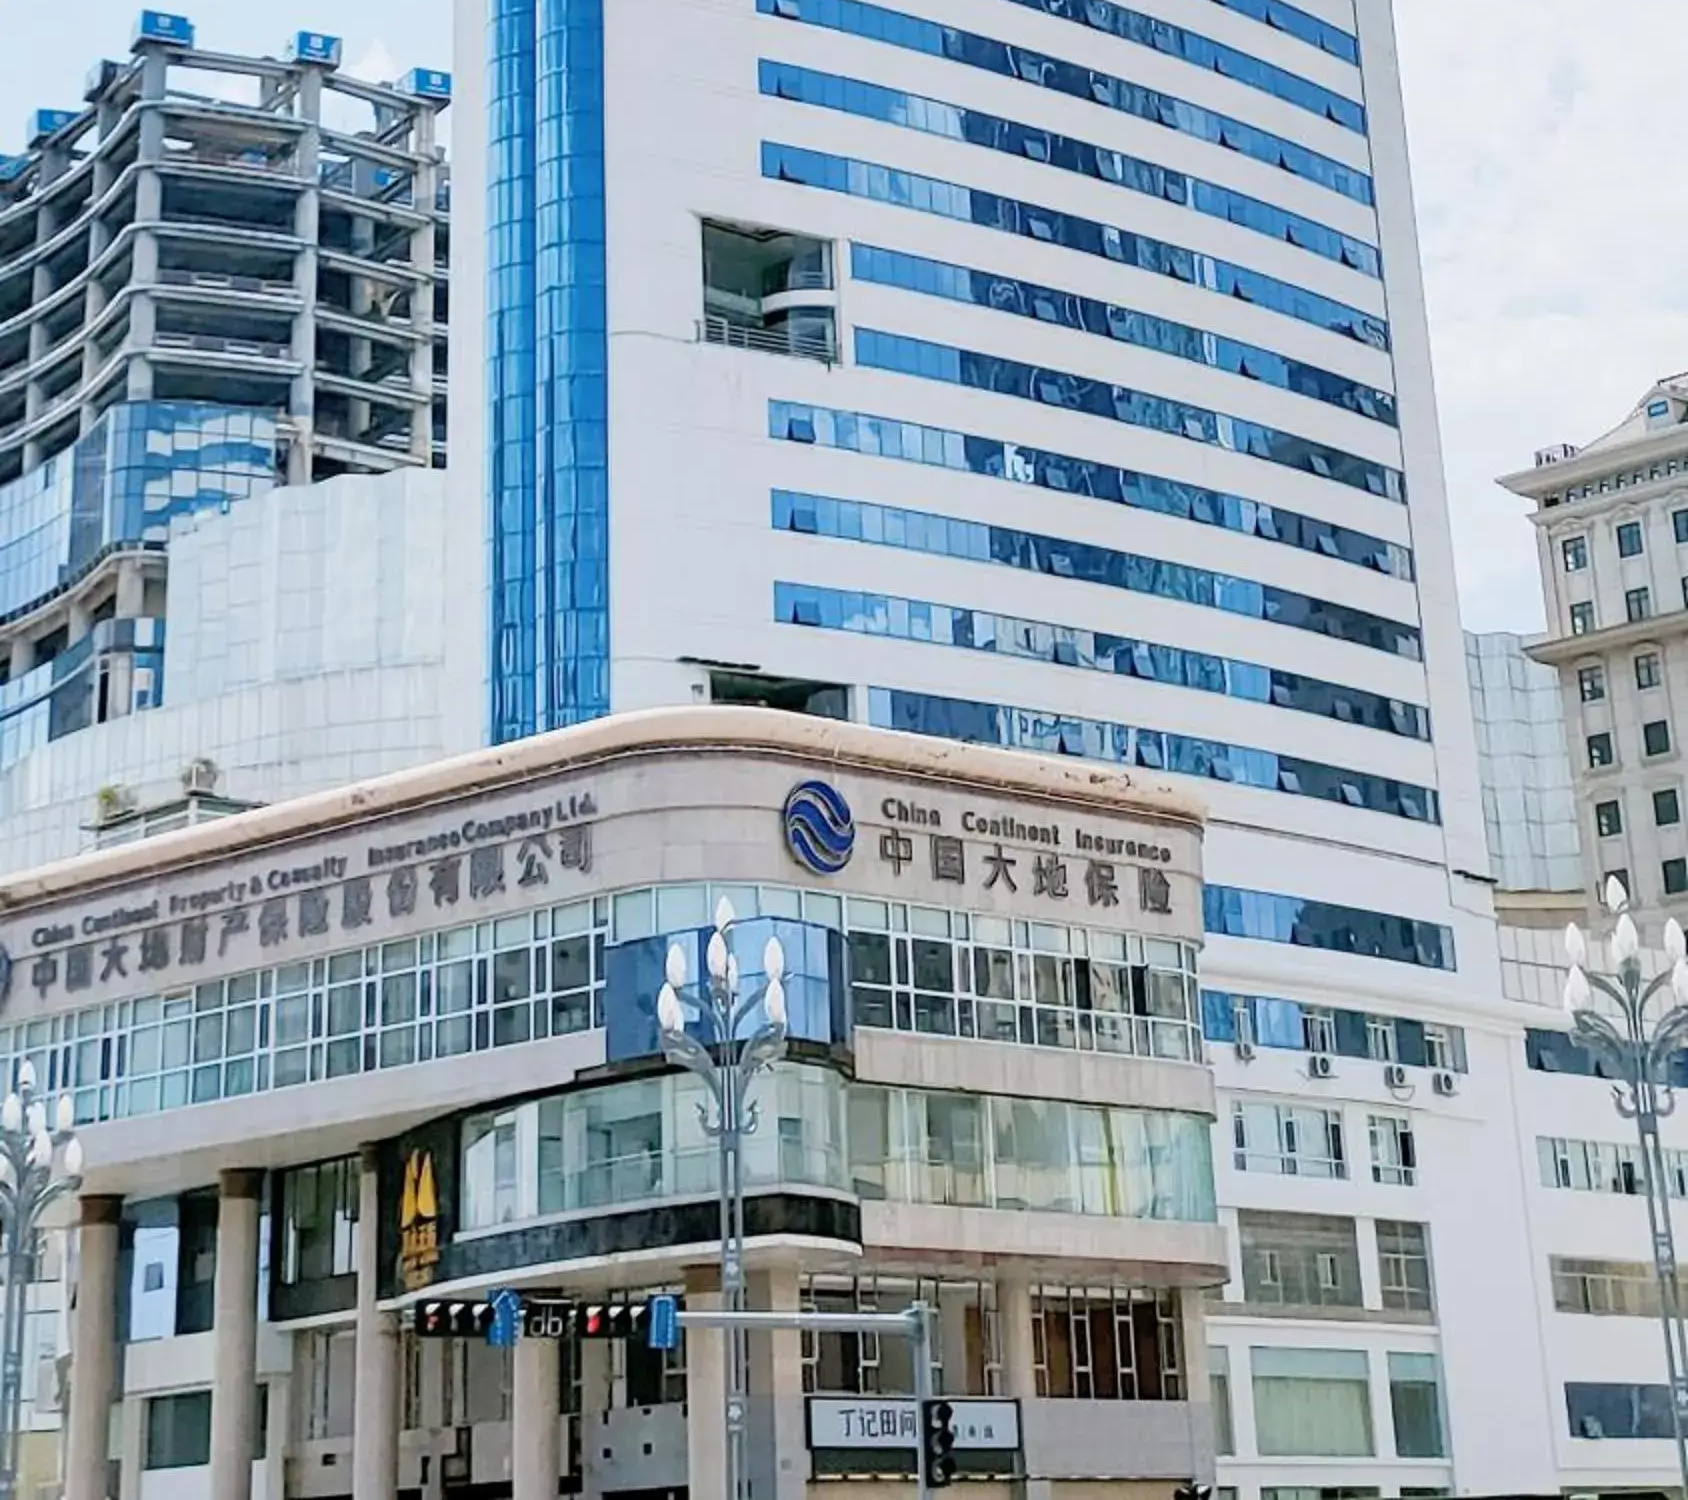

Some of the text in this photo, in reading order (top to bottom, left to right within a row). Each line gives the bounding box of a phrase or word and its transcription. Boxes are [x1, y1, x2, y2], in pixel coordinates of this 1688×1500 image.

[462, 807, 551, 843] Company
[881, 797, 1172, 863] China Continent Insurance
[879, 827, 1172, 914] 中国大地保险
